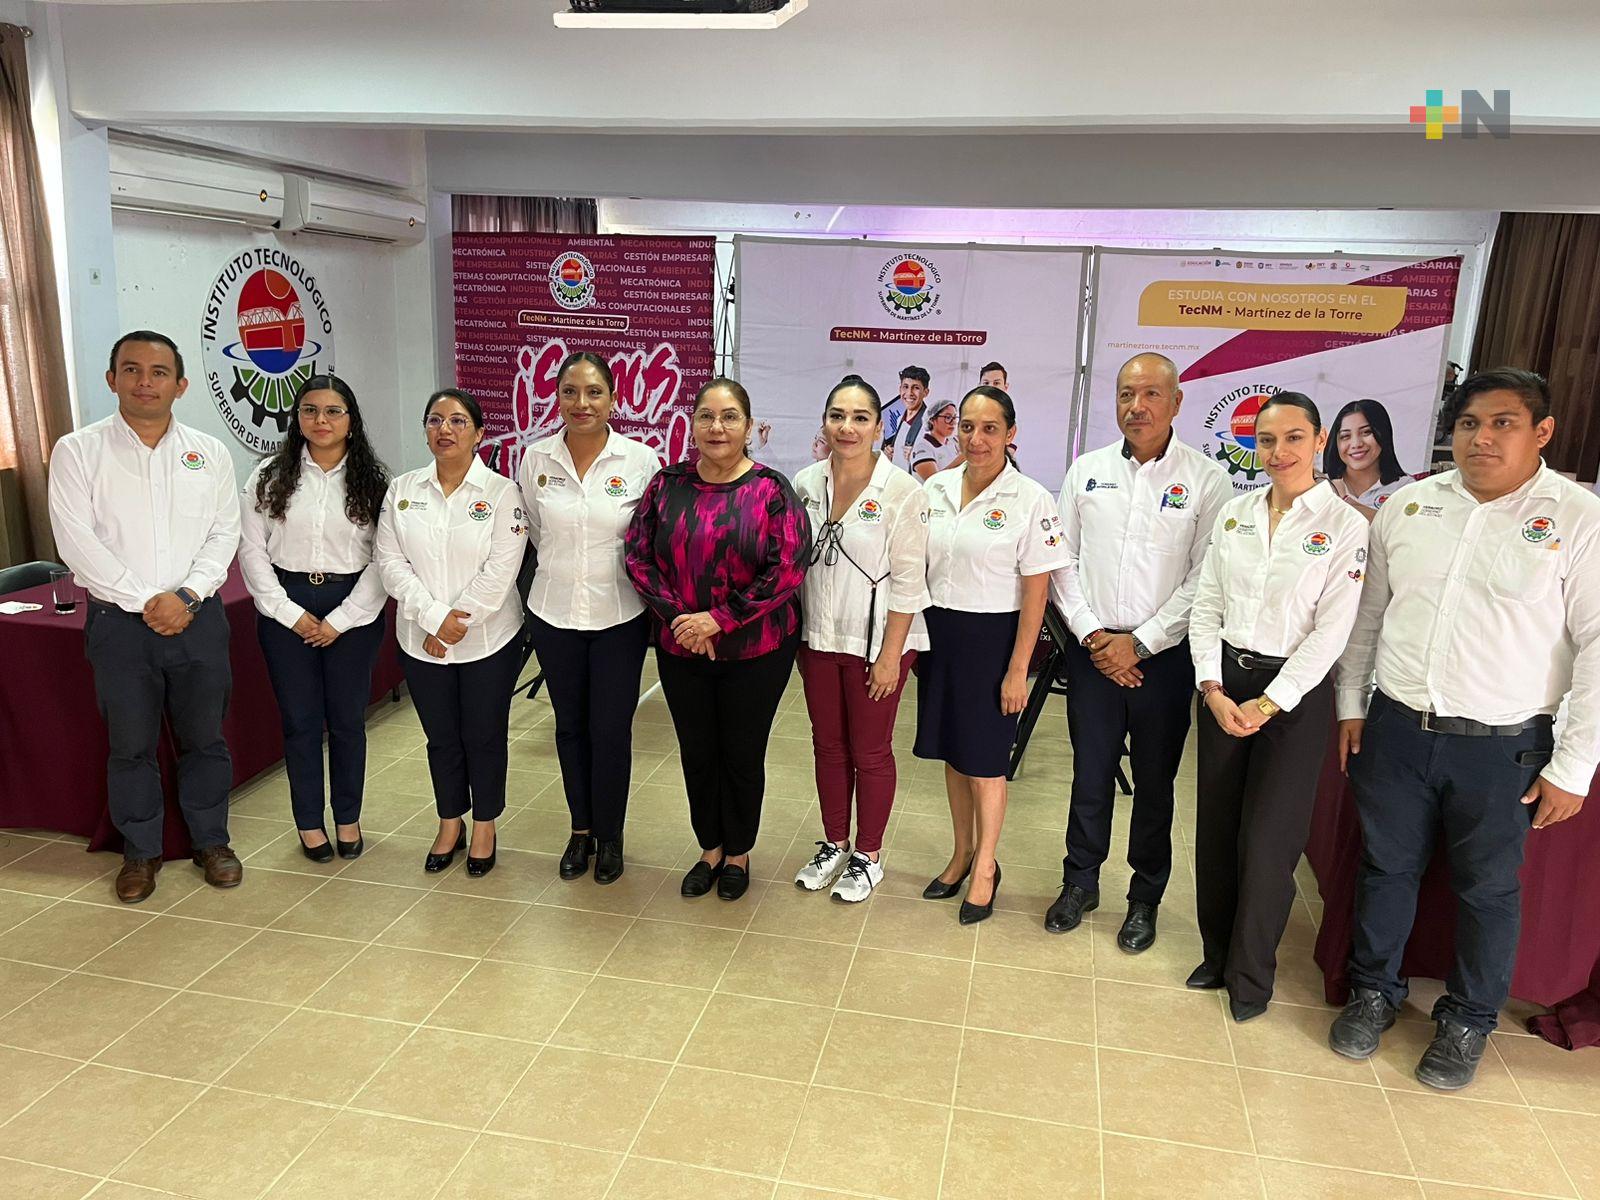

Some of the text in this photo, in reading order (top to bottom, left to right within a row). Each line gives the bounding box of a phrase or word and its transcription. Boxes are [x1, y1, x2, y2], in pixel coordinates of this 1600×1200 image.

[568, 239, 615, 247] AMBIENTAL
[623, 250, 660, 261] GESTIÓN
[652, 266, 702, 275] AMBIENTAL
[877, 253, 941, 284] INSTITUTO TECNOLÓGICO
[620, 278, 681, 288] MECATRÓNICA
[203, 248, 332, 341] INSTITUTO TECNOLÓGICO
[623, 289, 659, 299] GESTIÓN
[1168, 289, 1377, 306] ESTUDIA CON NOSOTROS EN EL
[608, 302, 691, 313] COMPUTACIONALES
[1179, 304, 1223, 315] TecNM
[1234, 306, 1291, 318] Martínez
[1294, 308, 1311, 318] de
[1314, 308, 1325, 318] la
[1330, 308, 1363, 320] Torre
[522, 313, 547, 323] TecNM
[553, 316, 585, 326] Martínez
[586, 317, 596, 326] de
[597, 317, 604, 326] la
[605, 318, 625, 328] Torre
[624, 328, 660, 338] GESTIÓN
[834, 329, 870, 339] TecNM
[880, 331, 925, 342] Martínez
[928, 332, 941, 342] de
[944, 332, 953, 342] la
[956, 333, 983, 343] Torre
[566, 337, 647, 349] COMPUTACIONALES
[1107, 341, 1200, 351] martineztorre.tecnm.mx
[455, 353, 508, 364] MECATRÓNICA
[208, 371, 246, 439] SUPERIOR
[246, 431, 260, 449] DE
[1204, 386, 1250, 429] INSTITUTO
